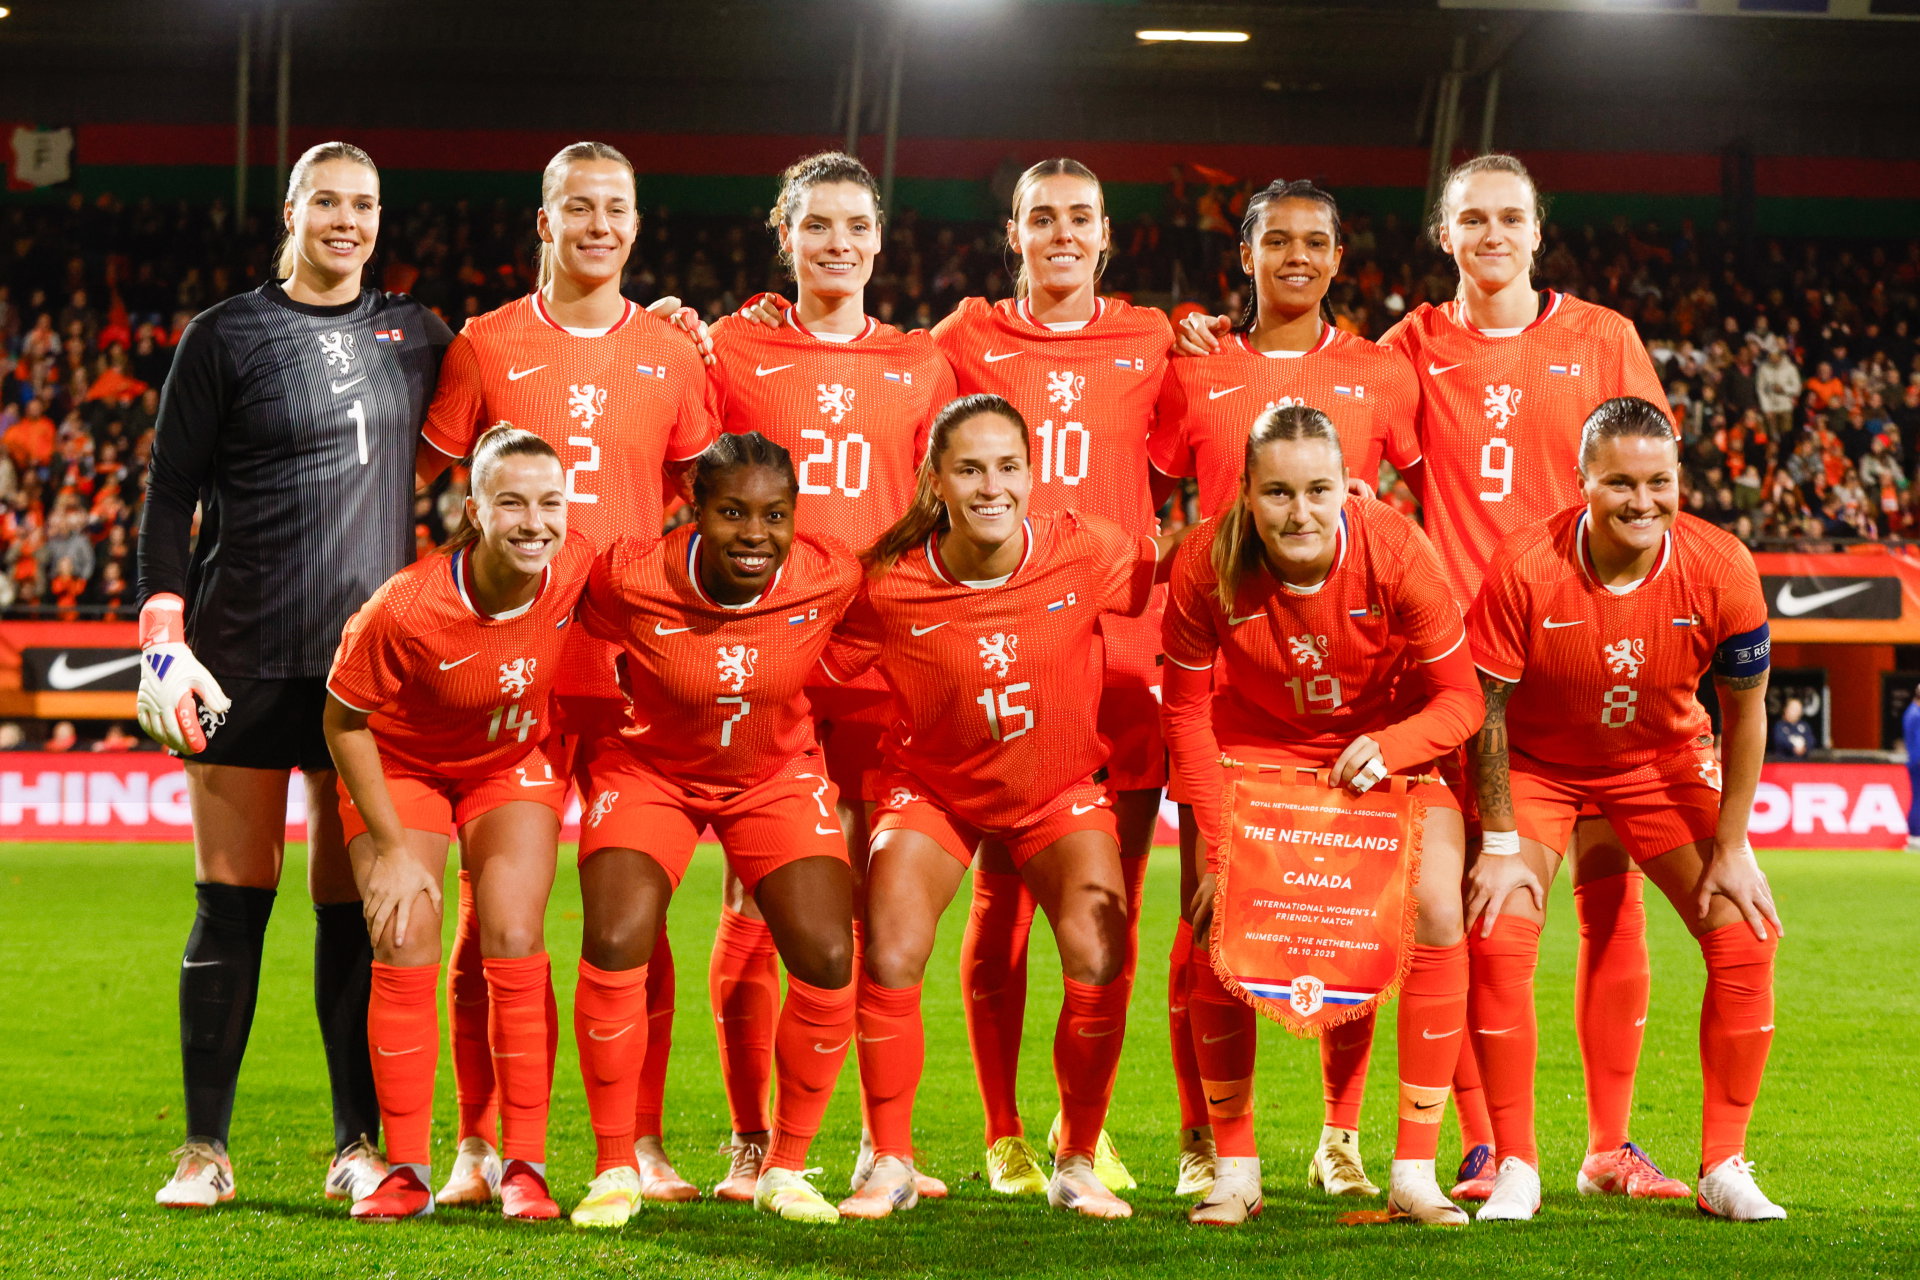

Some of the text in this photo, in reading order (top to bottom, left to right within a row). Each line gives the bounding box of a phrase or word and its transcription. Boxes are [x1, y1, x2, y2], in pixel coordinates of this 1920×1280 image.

[347, 400, 369, 465] 1
[1036, 419, 1090, 486] 10
[567, 436, 601, 504] 2
[799, 429, 870, 498] 20
[1480, 437, 1513, 502] 9
[977, 682, 1034, 742] 15
[1285, 674, 1342, 714] 19
[1602, 685, 1637, 728] 8
[486, 704, 538, 742] 14
[717, 696, 750, 747] 7
[1250, 800, 1397, 818] ROYAL NETHERLANDS FOOTBALL ASSOCIATION
[1244, 825, 1399, 851] THE NETHERLANDS
[1283, 871, 1352, 890] CANADA
[1253, 899, 1377, 917] INTERNATIONAL WOMEN'S A
[1276, 912, 1353, 926] FRIENDLY MATCH
[1297, 936, 1314, 945] THE
[1316, 938, 1379, 951] NETHERLANDS
